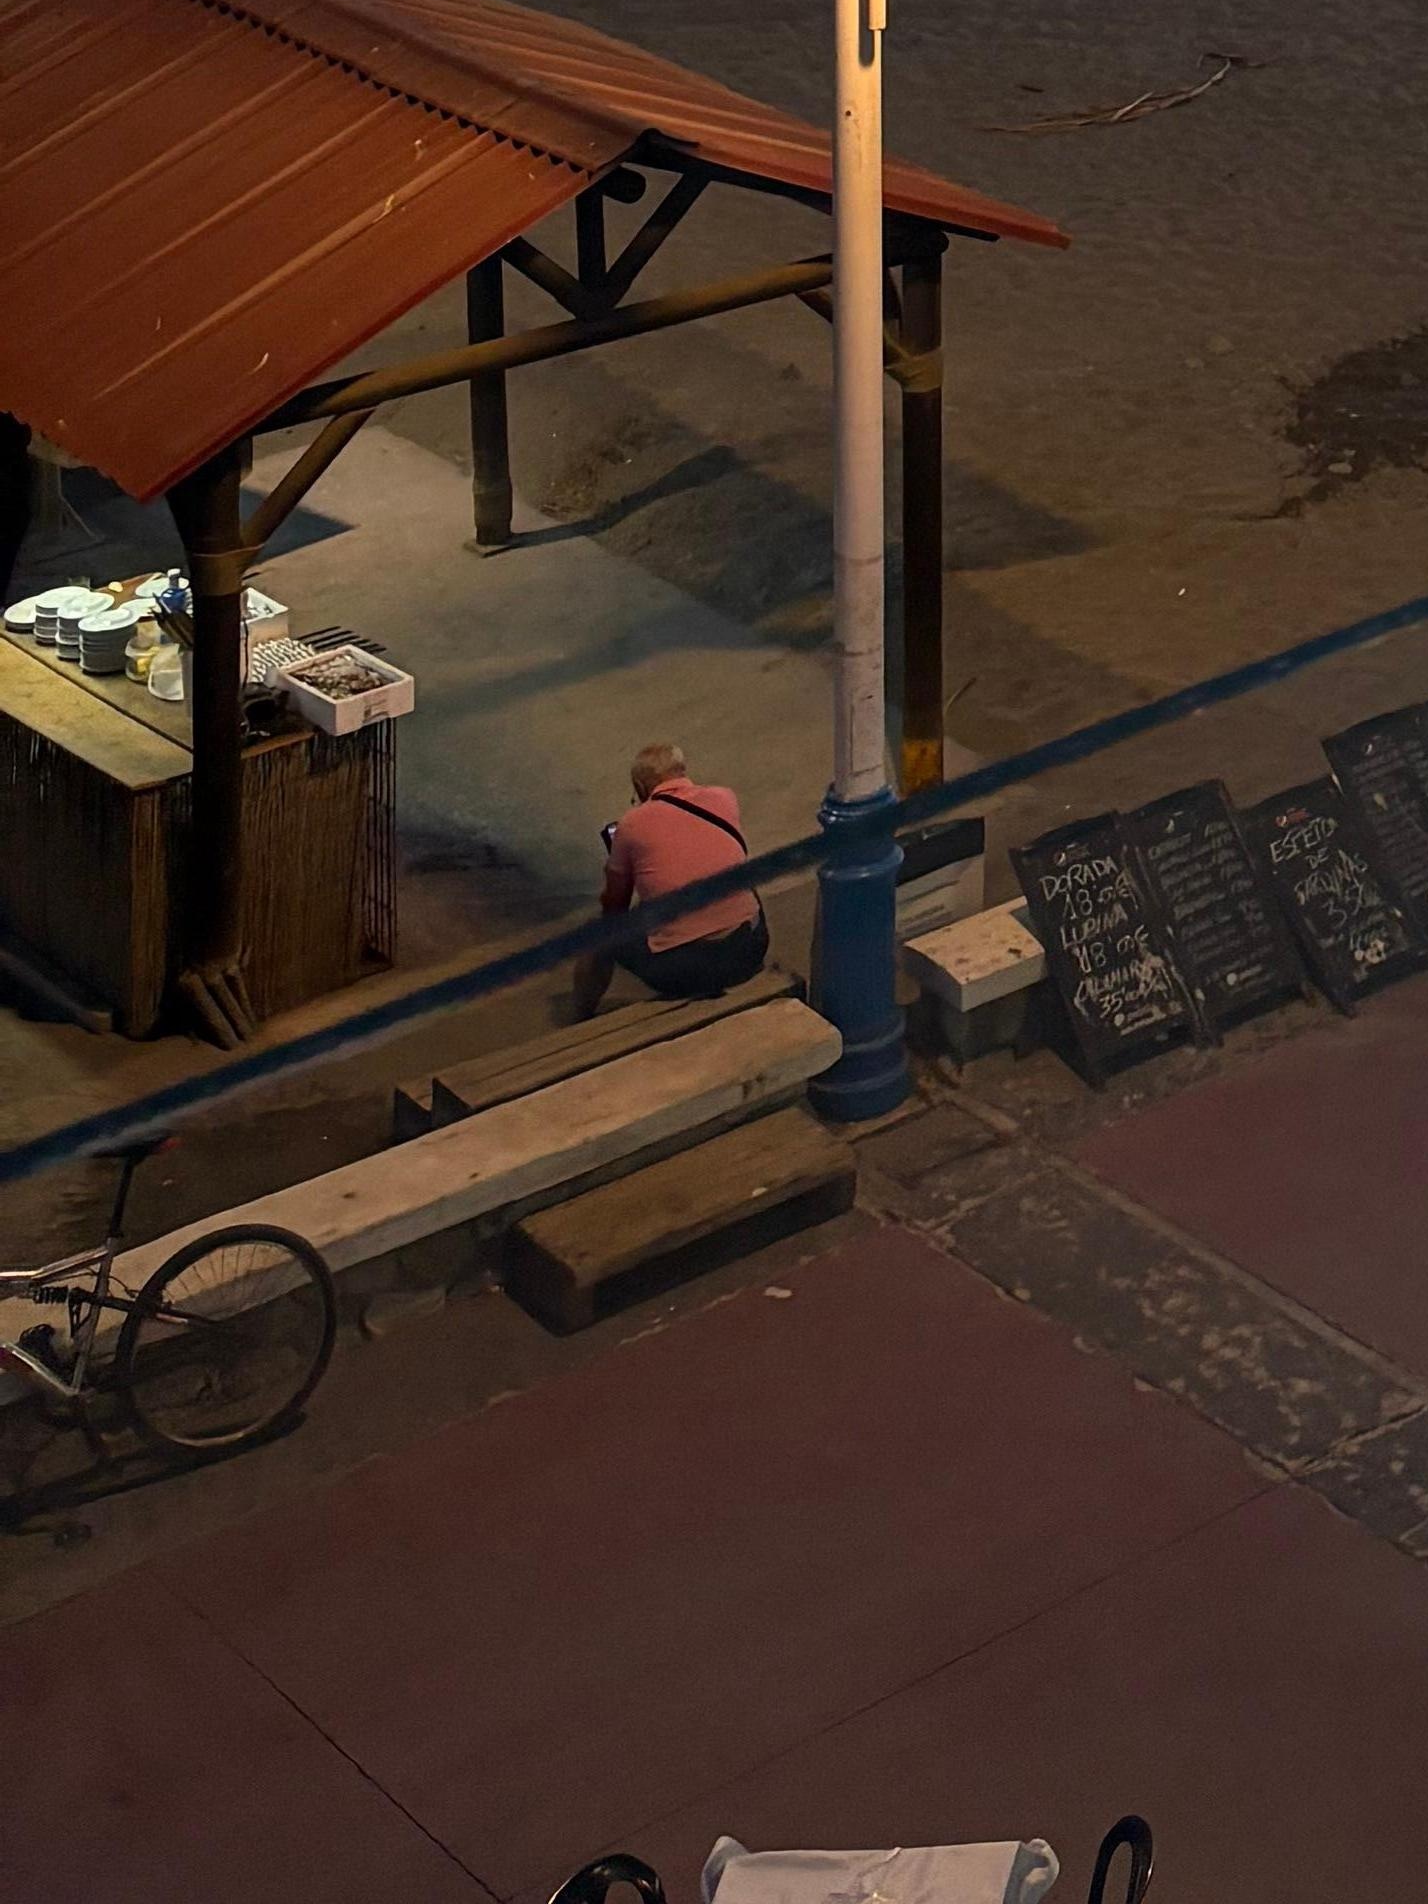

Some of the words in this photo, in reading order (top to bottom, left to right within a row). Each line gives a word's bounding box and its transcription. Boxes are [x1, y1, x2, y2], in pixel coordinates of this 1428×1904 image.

[1040, 856, 1120, 902] DORADA
[1305, 847, 1328, 869] DE
[1060, 903, 1128, 951] LUBINA
